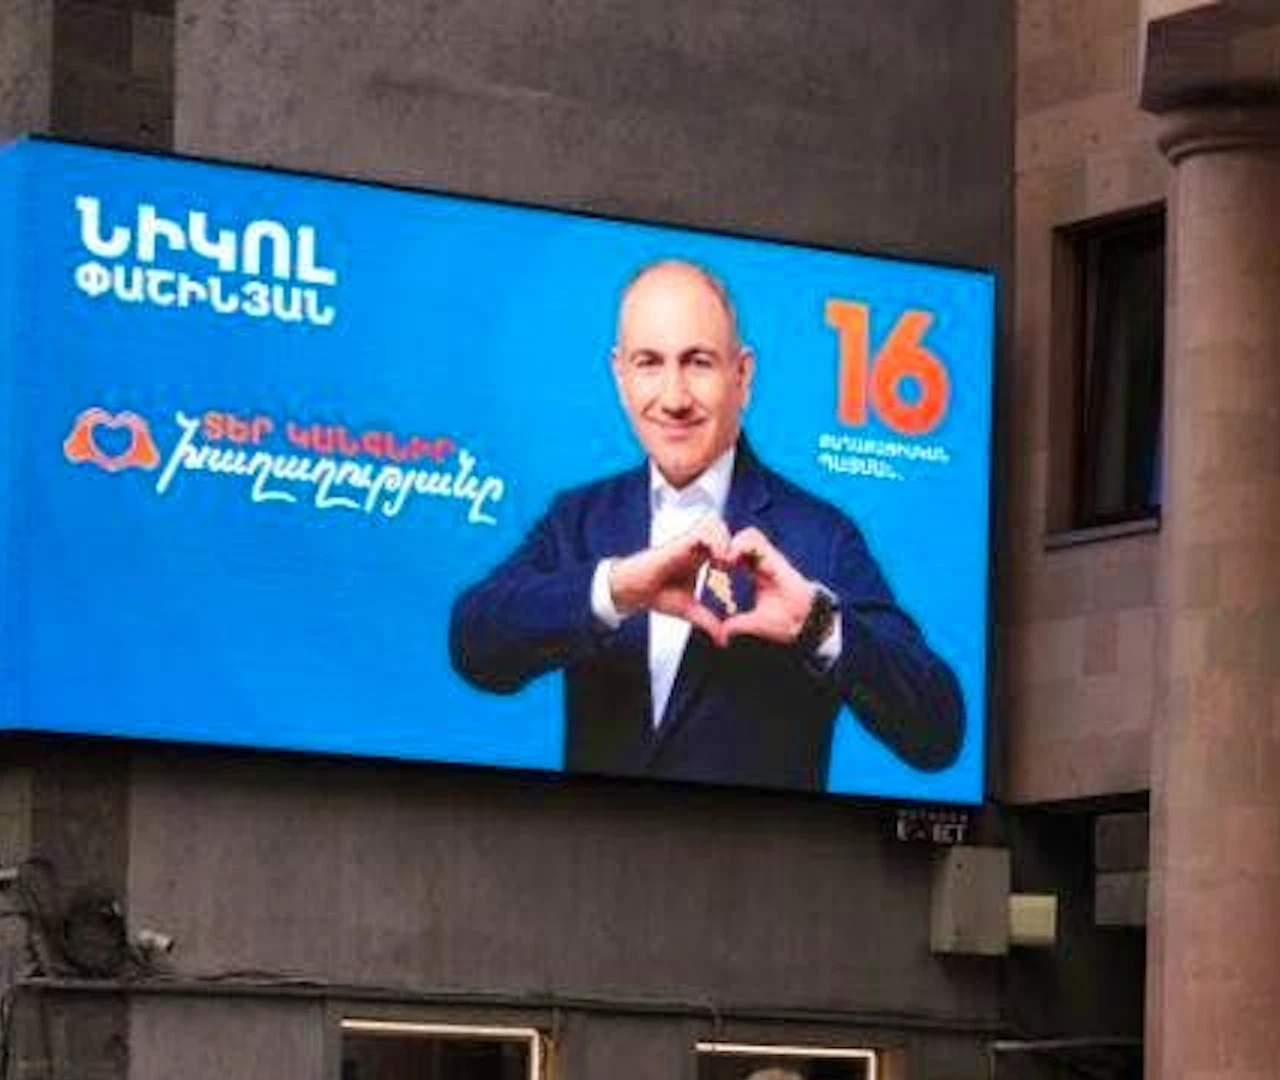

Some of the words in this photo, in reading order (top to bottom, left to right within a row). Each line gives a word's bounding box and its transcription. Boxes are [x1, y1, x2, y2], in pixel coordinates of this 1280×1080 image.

[75, 195, 337, 285] ՆԻԿՈԼ
[75, 261, 336, 326] ՓԱՇԻՆՅԱՆ
[825, 299, 952, 436] 16
[204, 411, 271, 444] ՏԵՐ
